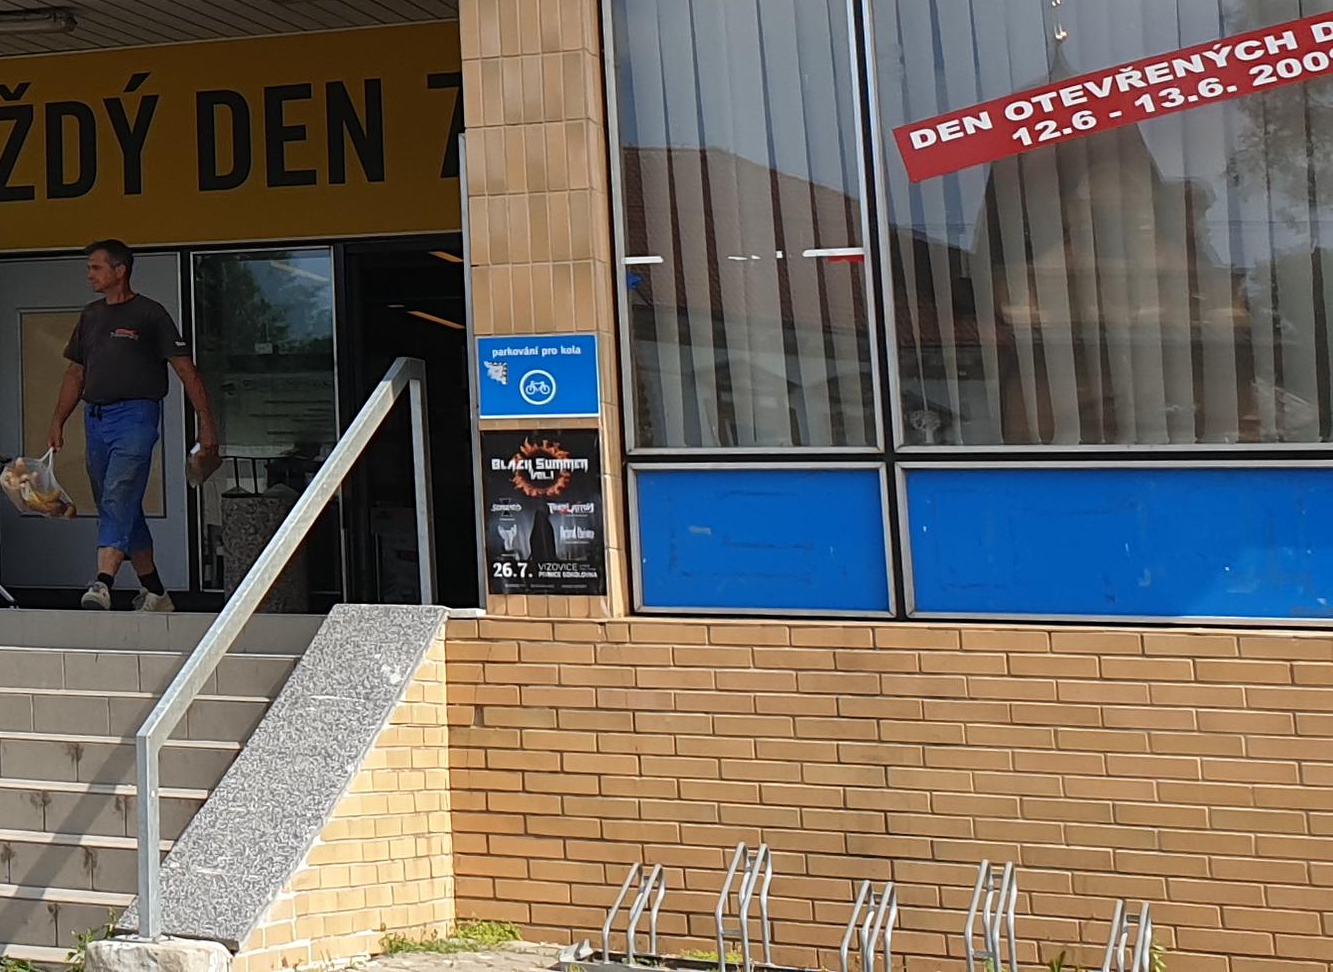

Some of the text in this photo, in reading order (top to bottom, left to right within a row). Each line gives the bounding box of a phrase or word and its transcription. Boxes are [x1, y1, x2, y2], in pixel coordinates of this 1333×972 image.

[194, 76, 386, 195] DEN
[909, 111, 993, 150] DEN
[1004, 30, 1299, 122] OTEVŘENÝCH
[1012, 110, 1097, 146] 12.6
[1134, 77, 1238, 113] 13.6.
[1248, 48, 1333, 87] 200
[492, 344, 581, 359] parkování pro kola
[493, 562, 533, 578] 26.7.
